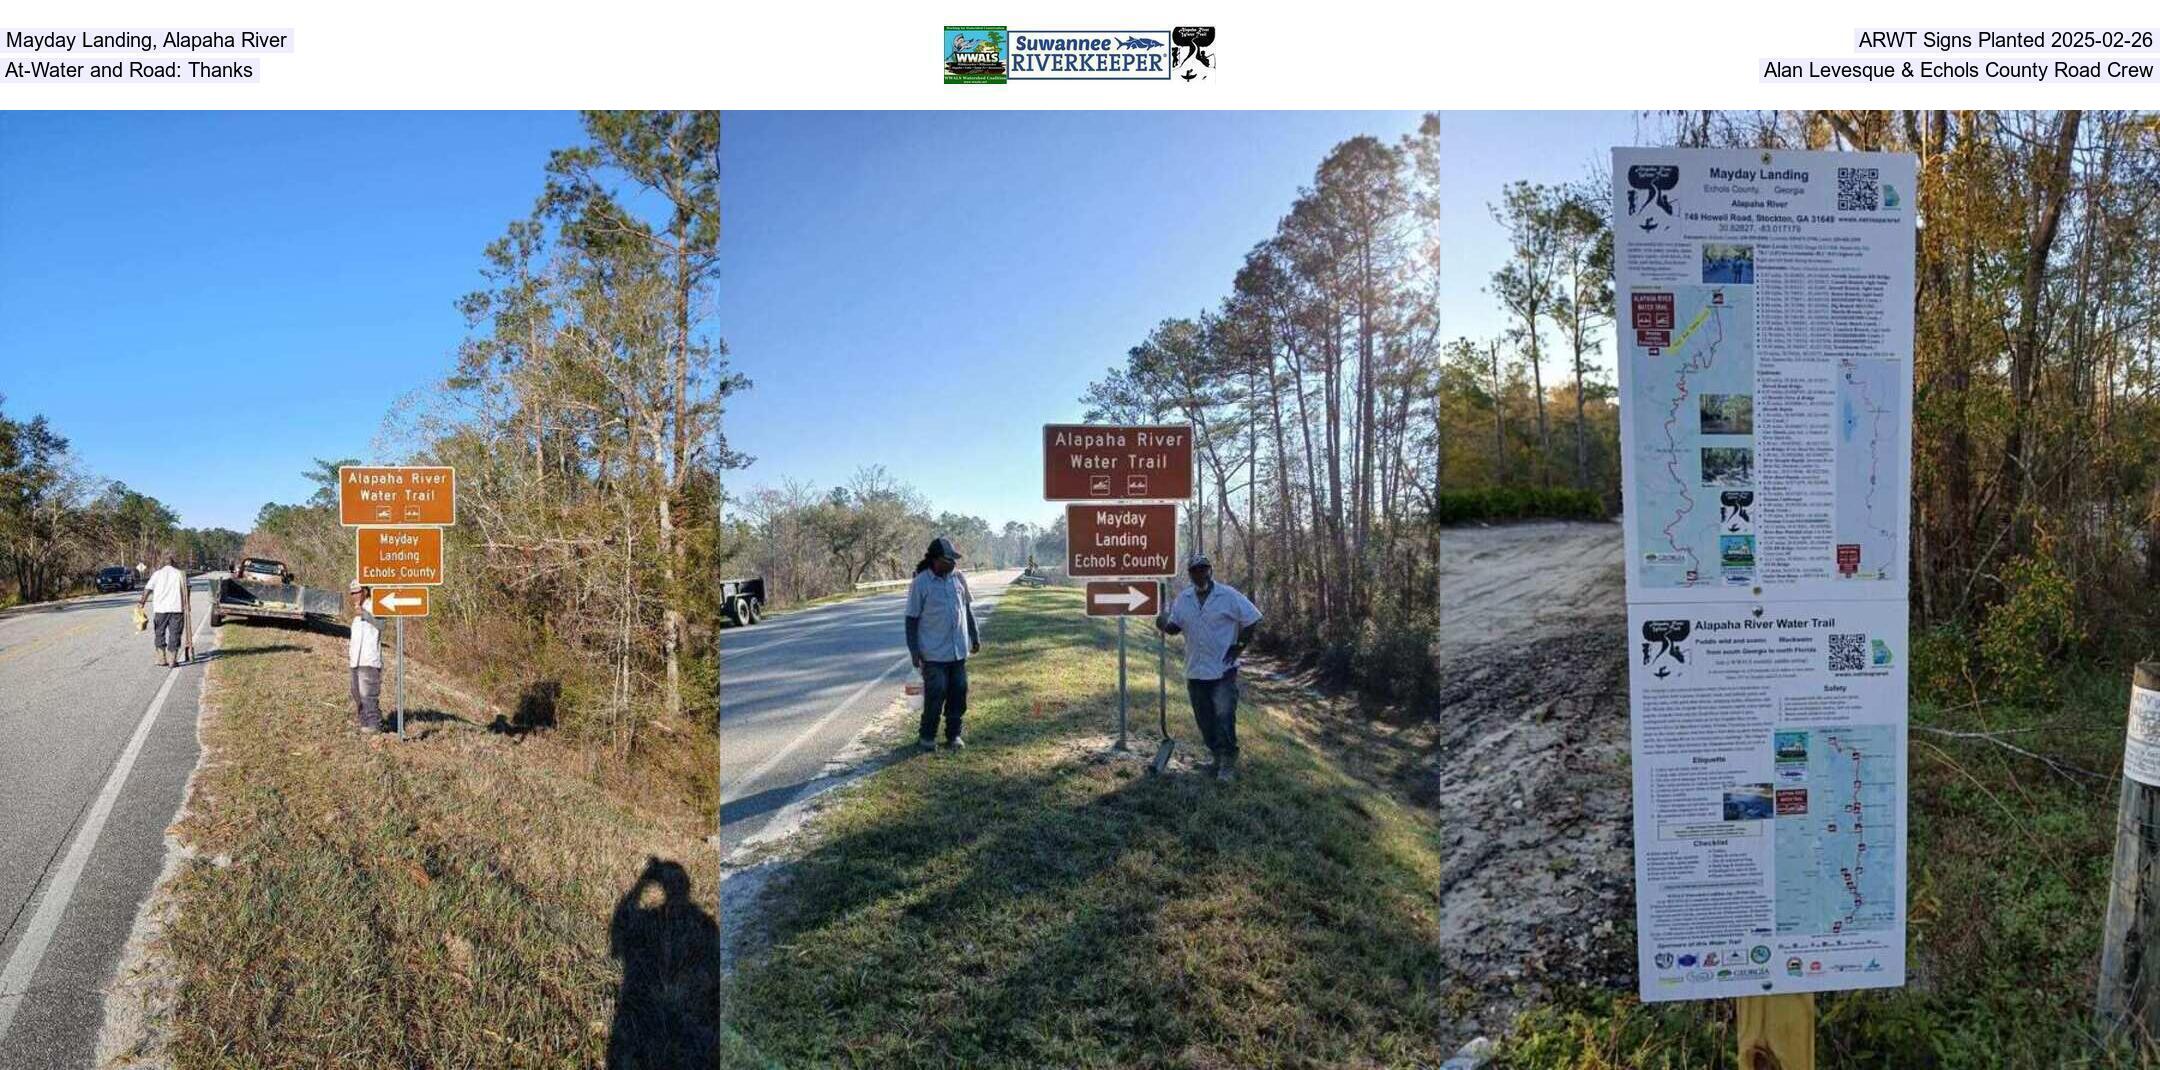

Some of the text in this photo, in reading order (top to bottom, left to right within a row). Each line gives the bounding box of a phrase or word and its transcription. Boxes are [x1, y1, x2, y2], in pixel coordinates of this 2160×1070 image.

[1710, 167, 1809, 183] Mayday Landing
[1731, 200, 1788, 208] Alapaha River
[1055, 432, 1184, 449] Alapaha River
[1070, 454, 1167, 468] Water Trail
[348, 473, 446, 486] Alapaha River
[360, 490, 435, 501] Water Trail
[1096, 511, 1147, 527] Mayday
[380, 534, 419, 547] Mayday
[1096, 533, 1147, 549] Landing
[380, 550, 420, 563] Landing
[1075, 554, 1168, 569] Echols County
[363, 567, 436, 579] Echols County
[1695, 620, 1741, 632] Alapaha
[1744, 619, 1774, 629] River
[1776, 619, 1809, 629] Water
[1810, 618, 1835, 628] Trail
